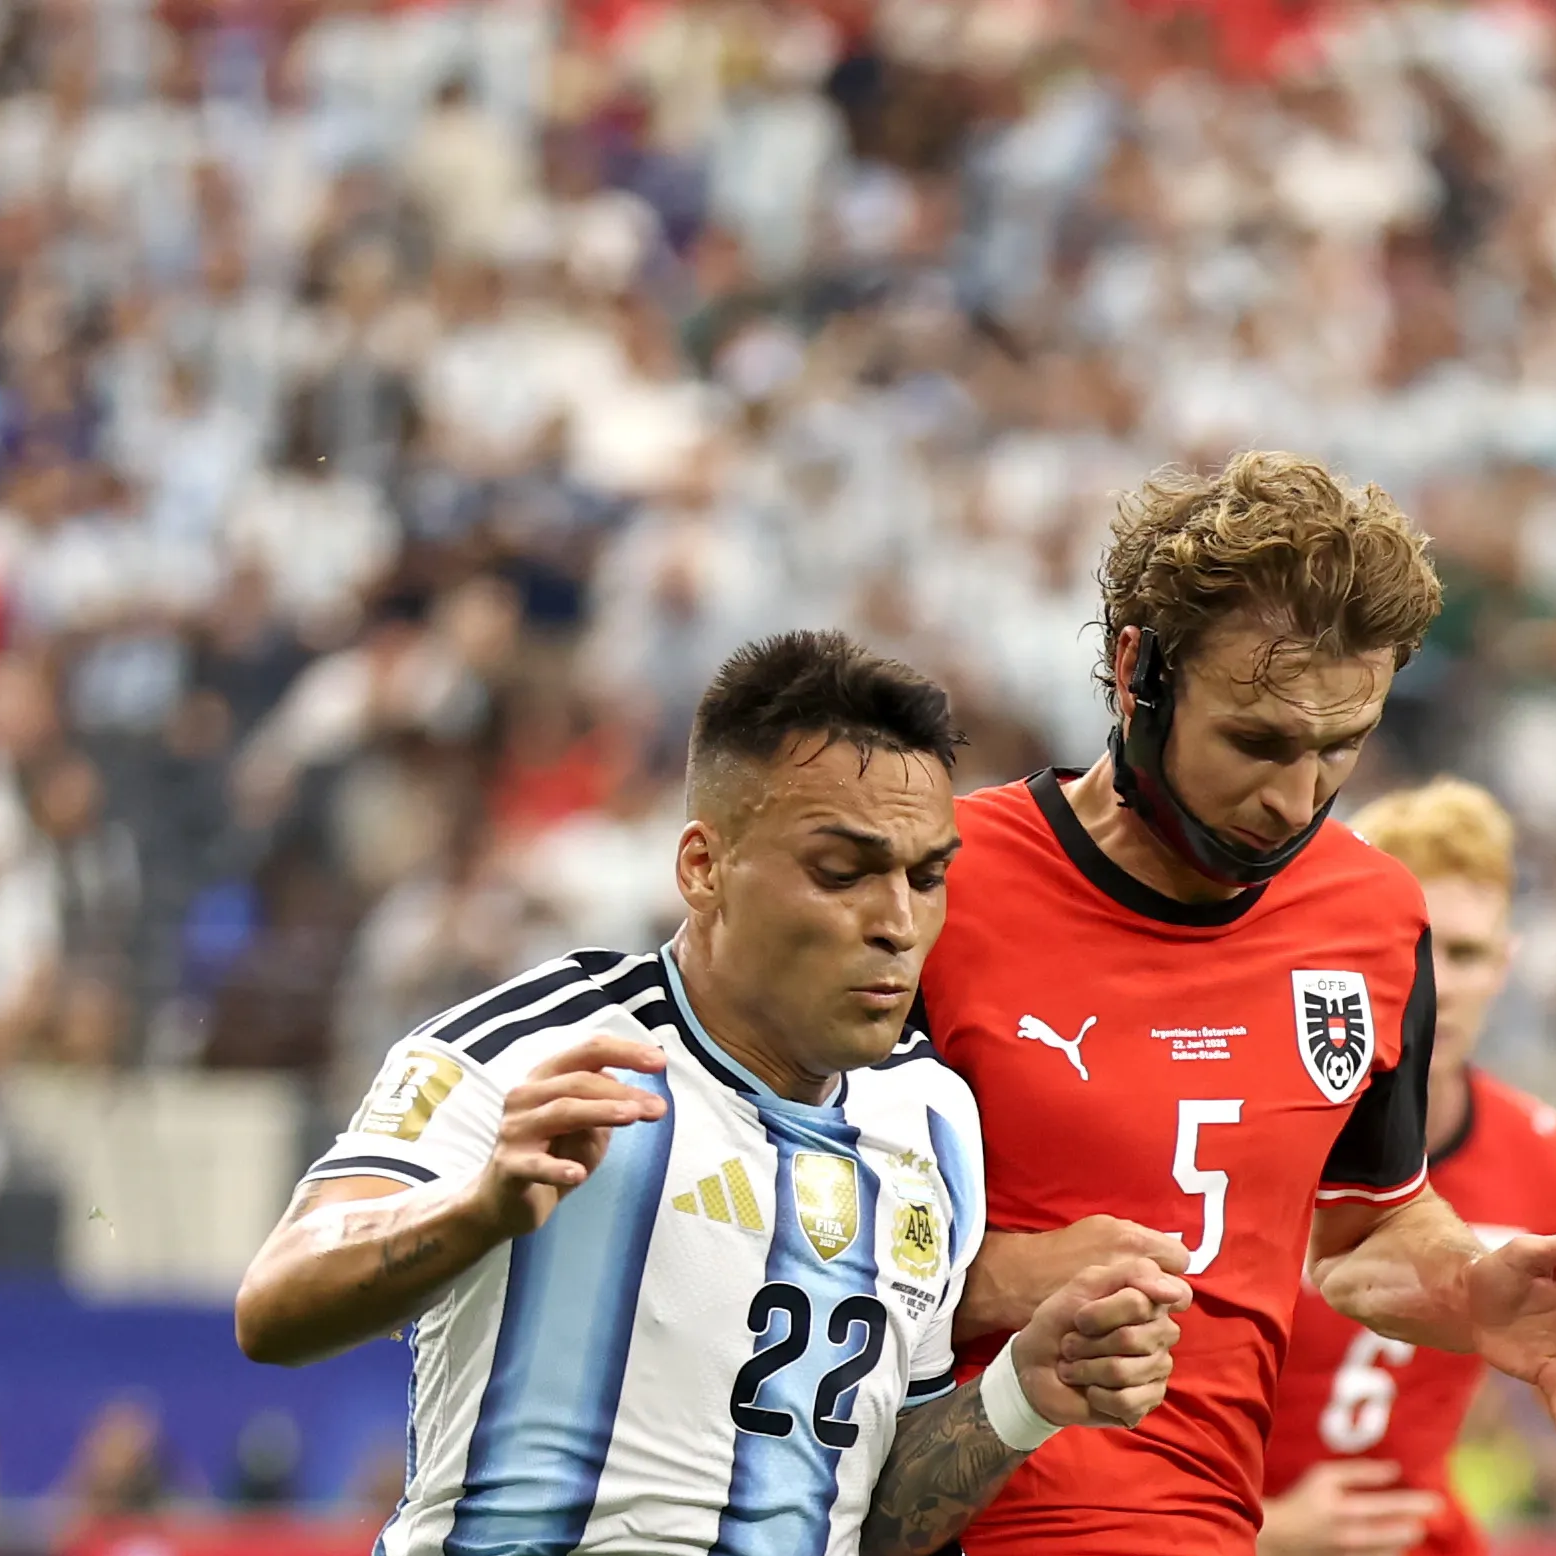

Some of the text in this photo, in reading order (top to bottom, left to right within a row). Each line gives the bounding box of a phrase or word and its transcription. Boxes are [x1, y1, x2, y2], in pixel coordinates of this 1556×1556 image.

[1318, 978, 1347, 991] ÖFB
[814, 1217, 843, 1236] FIFA
[1163, 1099, 1244, 1275] 5
[729, 1281, 887, 1449] 22
[1319, 1328, 1416, 1454] 6
